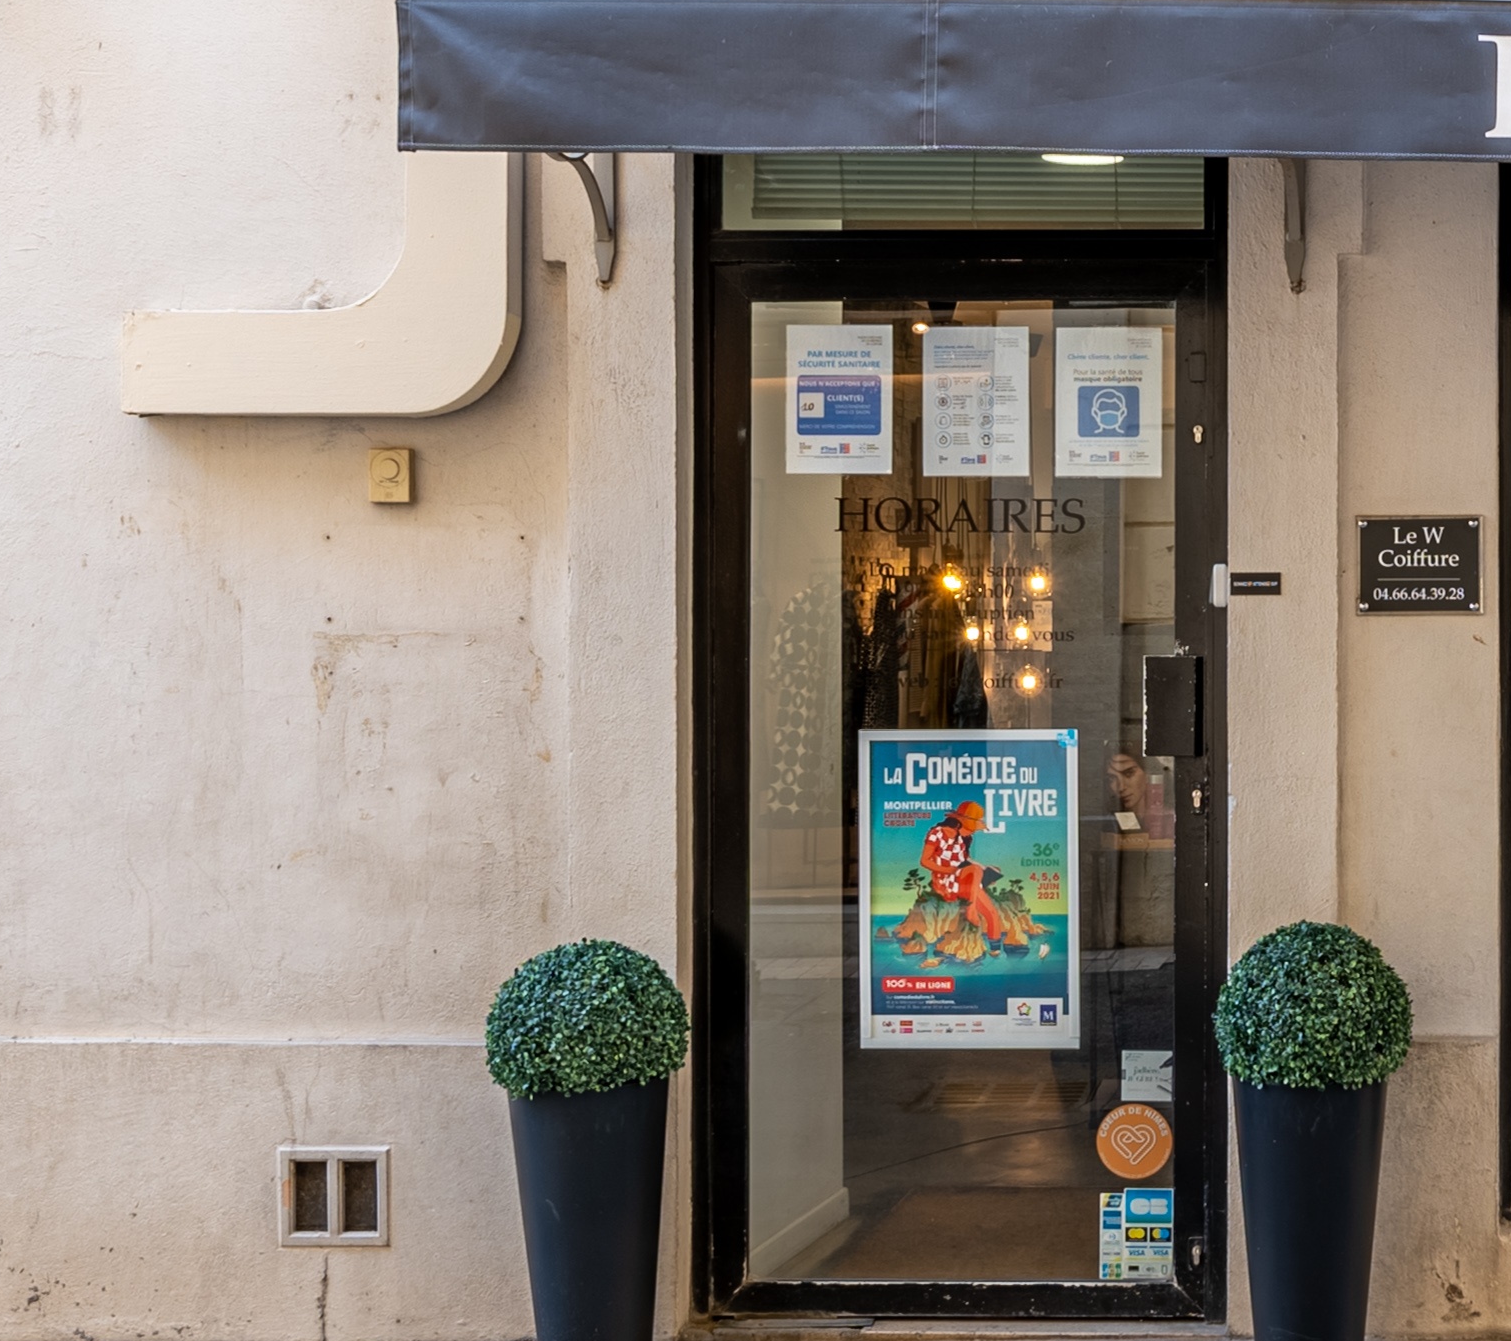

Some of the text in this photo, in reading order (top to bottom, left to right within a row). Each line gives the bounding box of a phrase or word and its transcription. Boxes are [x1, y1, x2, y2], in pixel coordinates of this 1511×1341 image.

[798, 359, 880, 368] SÉCURITÉ SANITAIRE
[1103, 375, 1143, 383] obligatoire
[827, 394, 864, 402] CLIENT(S)
[801, 402, 815, 411] 10
[834, 496, 1087, 534] HORAIRES
[1393, 527, 1445, 545] Le W
[1378, 549, 1460, 568] Coiffure
[1373, 587, 1465, 601] 04.66.64.39.28
[884, 767, 902, 785] LA
[1020, 767, 1038, 784] DU
[884, 801, 953, 810] MONTPELLIER
[983, 788, 1058, 834] LIVRE
[1021, 858, 1060, 867] ÉDITION
[1037, 882, 1060, 891] JUIN
[1037, 891, 1060, 900] 2021
[915, 981, 926, 989] EN
[927, 981, 952, 989] LIGNE
[1099, 1108, 1126, 1137] COEUR
[1128, 1106, 1142, 1115] DE
[1130, 1197, 1168, 1216] CB
